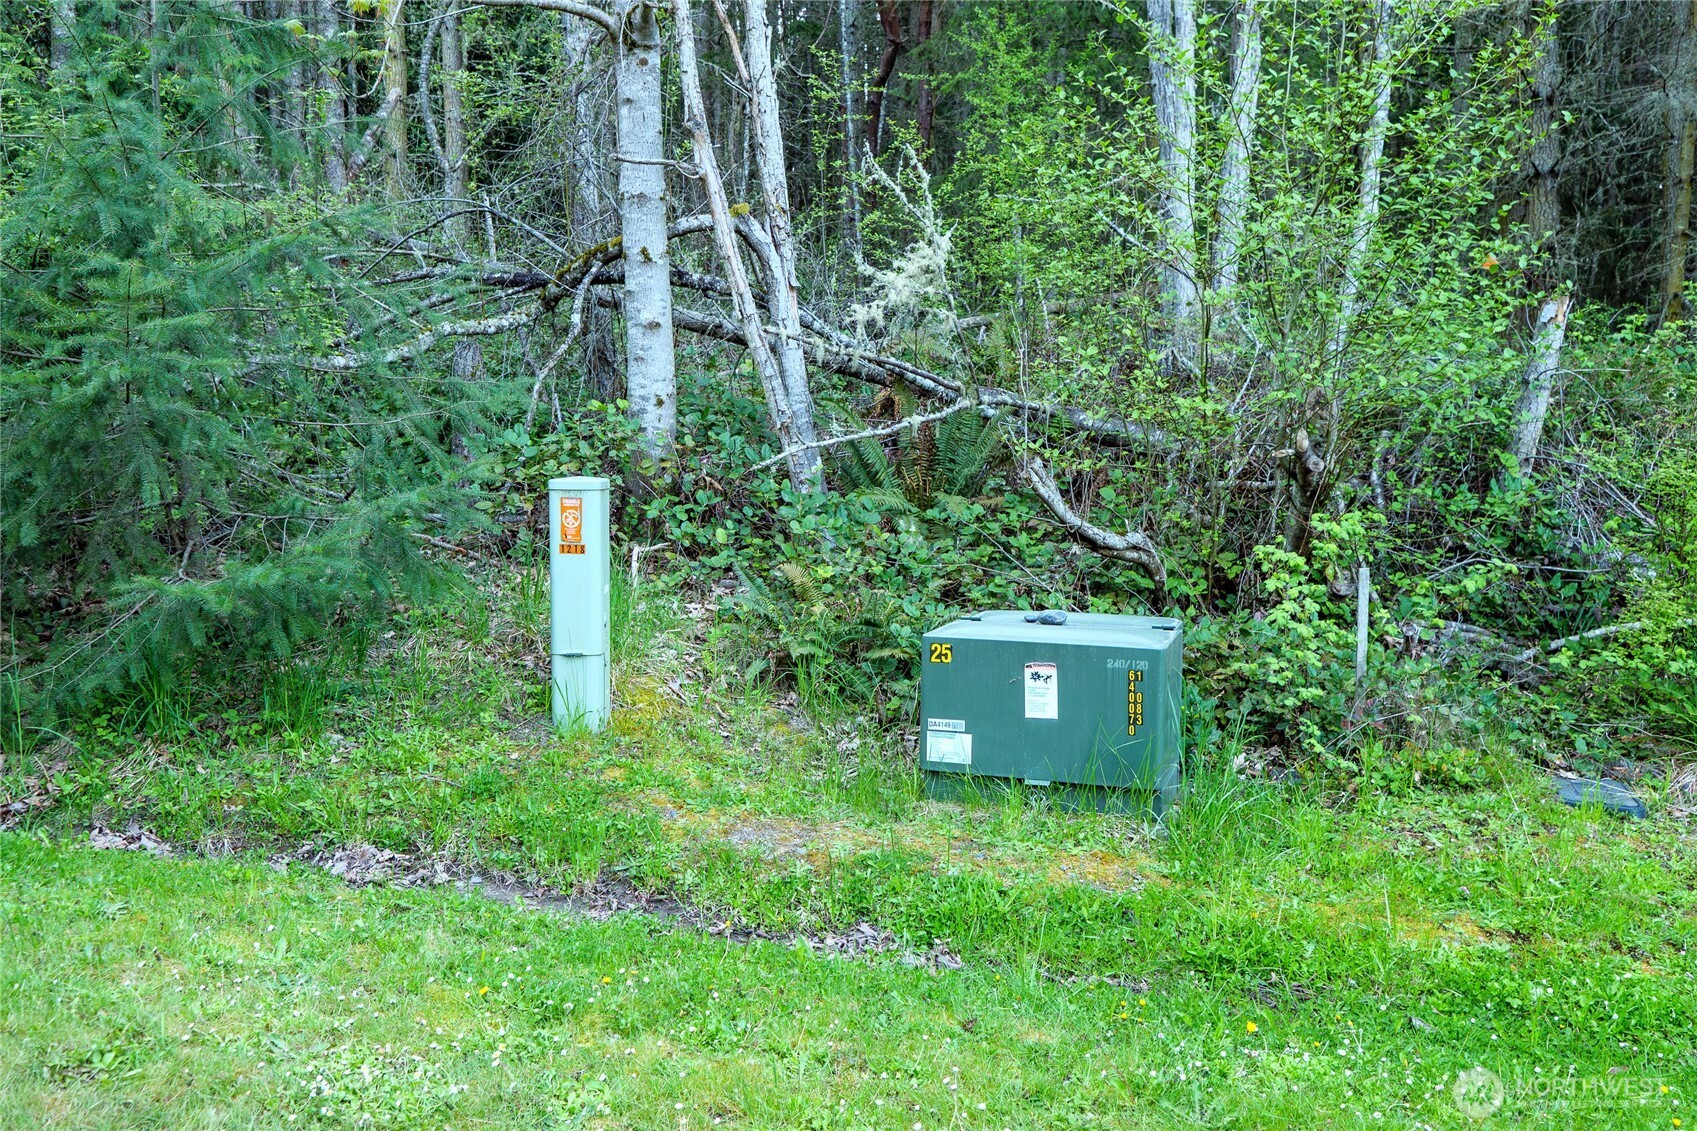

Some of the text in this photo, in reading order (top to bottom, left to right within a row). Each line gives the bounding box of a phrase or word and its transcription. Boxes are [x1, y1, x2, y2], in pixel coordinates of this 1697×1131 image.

[561, 545, 585, 554] 1218
[930, 643, 952, 663] 25
[1107, 659, 1149, 670] 240/120
